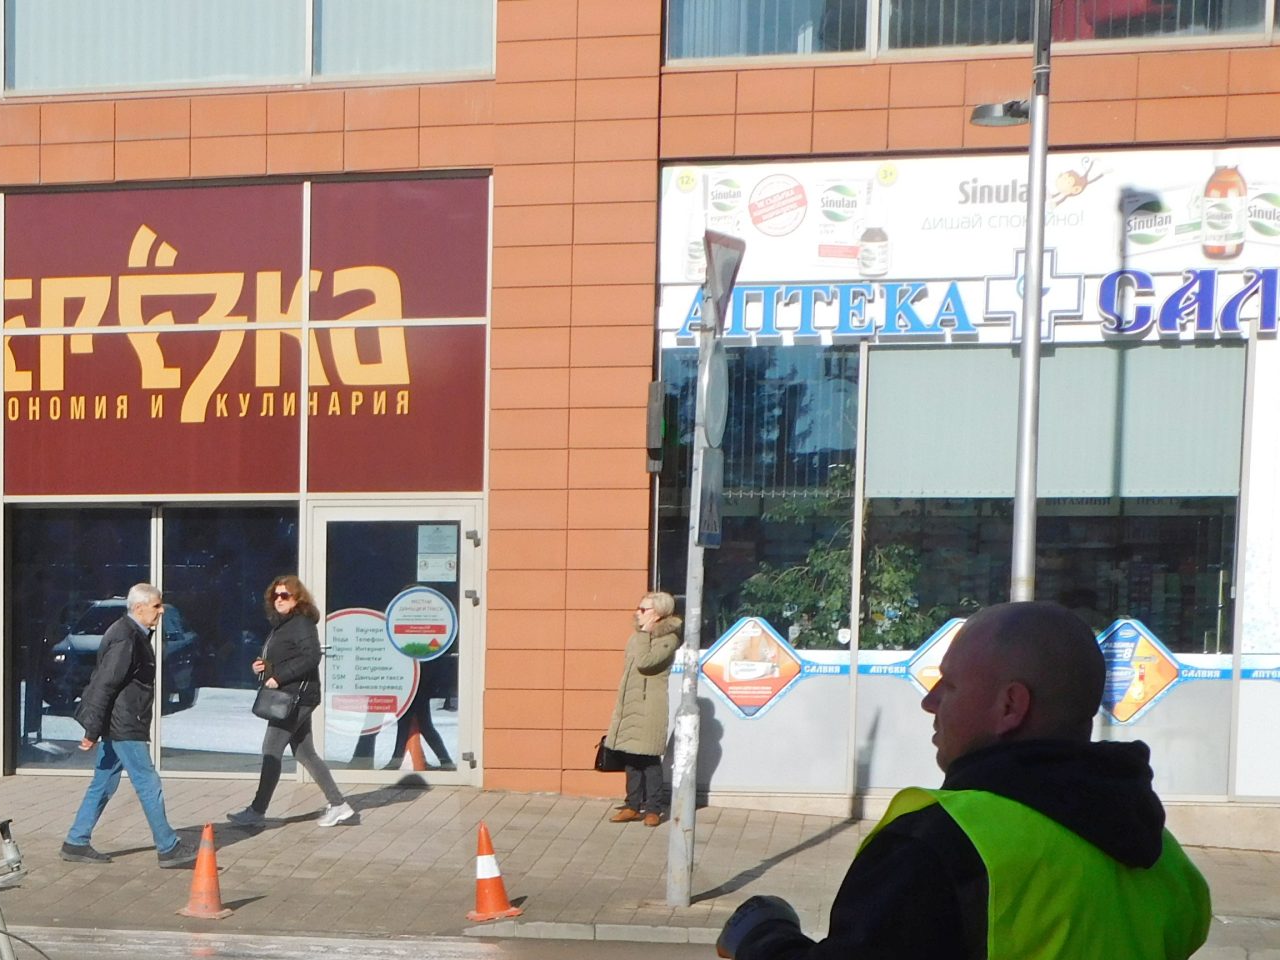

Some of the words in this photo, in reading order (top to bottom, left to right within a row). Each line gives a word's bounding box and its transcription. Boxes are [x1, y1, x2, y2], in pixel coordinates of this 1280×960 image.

[958, 177, 1031, 205] Sinula
[820, 196, 858, 209] Sinulan
[1126, 213, 1172, 233] Sinulan
[675, 280, 980, 338] АПТЕКА
[151, 394, 164, 418] И
[216, 390, 410, 418] КУЛИНАРИЯ
[804, 665, 841, 674] САЛВИЯ
[869, 665, 906, 674] АПТЕКИ
[1181, 670, 1221, 678] САЛВИЯ
